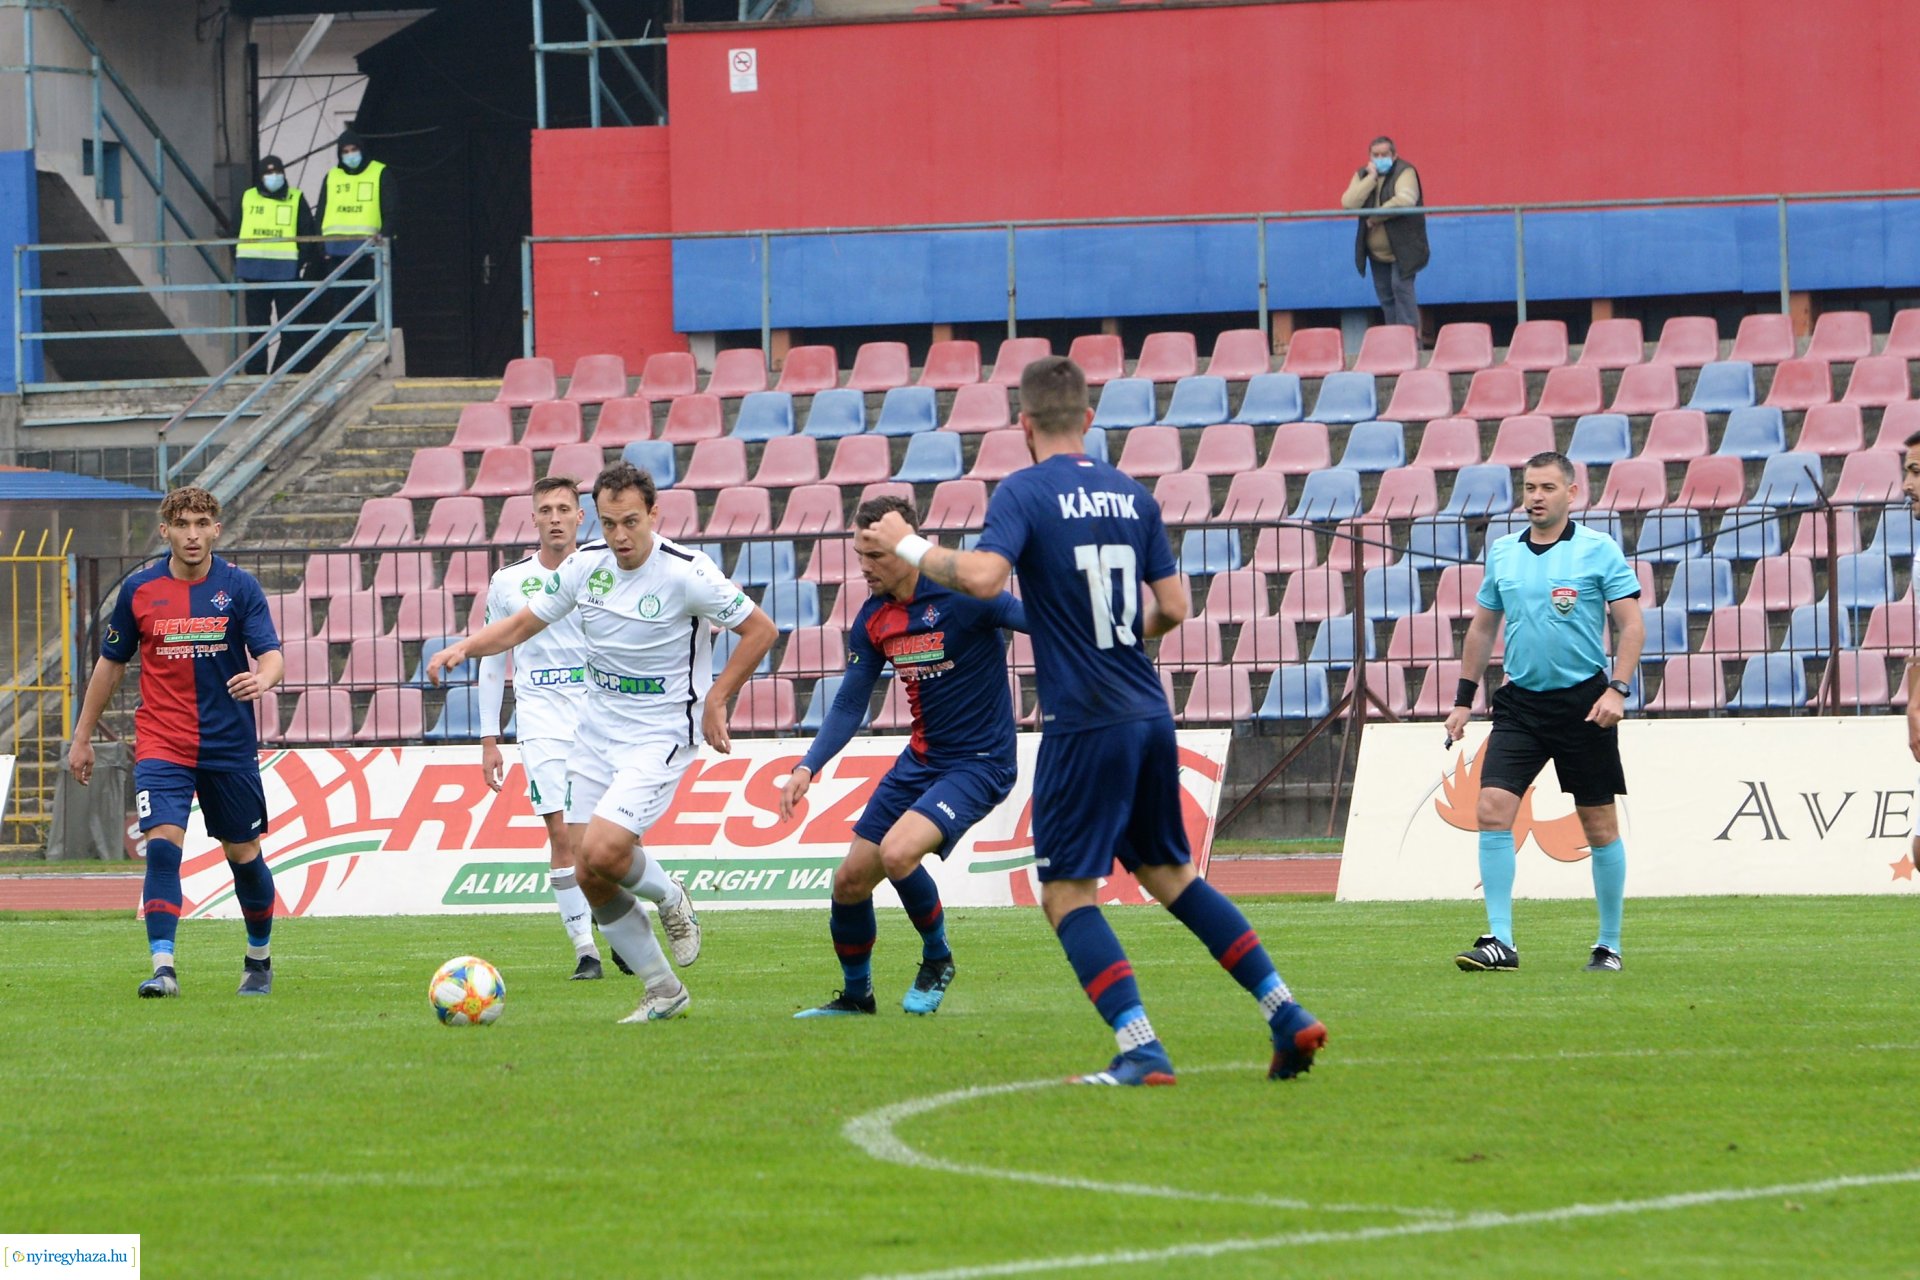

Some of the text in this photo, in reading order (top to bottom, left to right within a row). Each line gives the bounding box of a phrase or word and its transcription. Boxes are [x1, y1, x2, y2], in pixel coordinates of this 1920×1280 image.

[587, 596, 604, 607] JAKO
[1074, 544, 1137, 649] 10
[153, 617, 229, 635] REVESZ
[530, 780, 541, 804] 4
[381, 755, 899, 851] REESZ
[617, 806, 634, 818] JAKO
[937, 801, 955, 820] JAKO
[690, 869, 784, 890] RIGHT
[787, 868, 833, 890] WA
